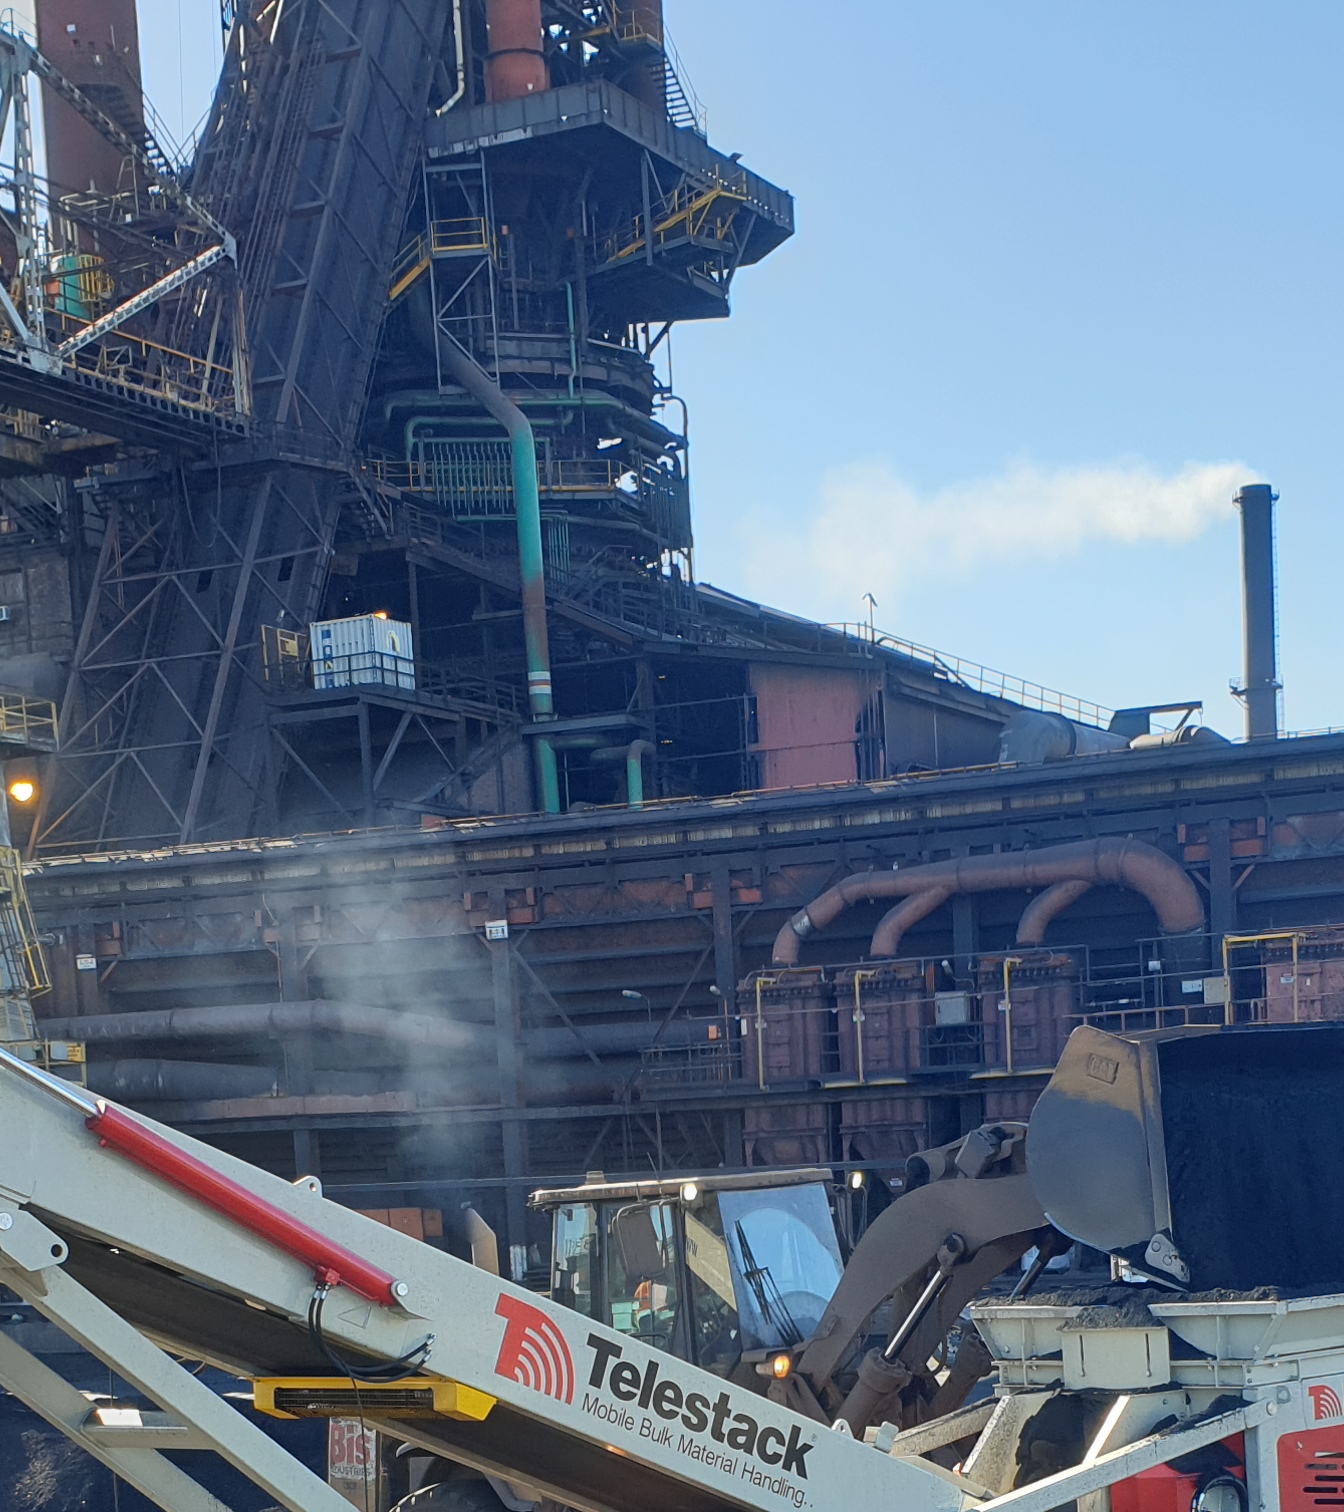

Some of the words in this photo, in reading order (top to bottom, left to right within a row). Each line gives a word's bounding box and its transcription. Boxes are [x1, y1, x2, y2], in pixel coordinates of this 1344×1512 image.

[331, 1424, 371, 1465] Bis
[582, 1392, 636, 1431] Mobile
[639, 1417, 673, 1448] Bulk
[677, 1434, 739, 1476] Material
[586, 1332, 815, 1481] Telestack
